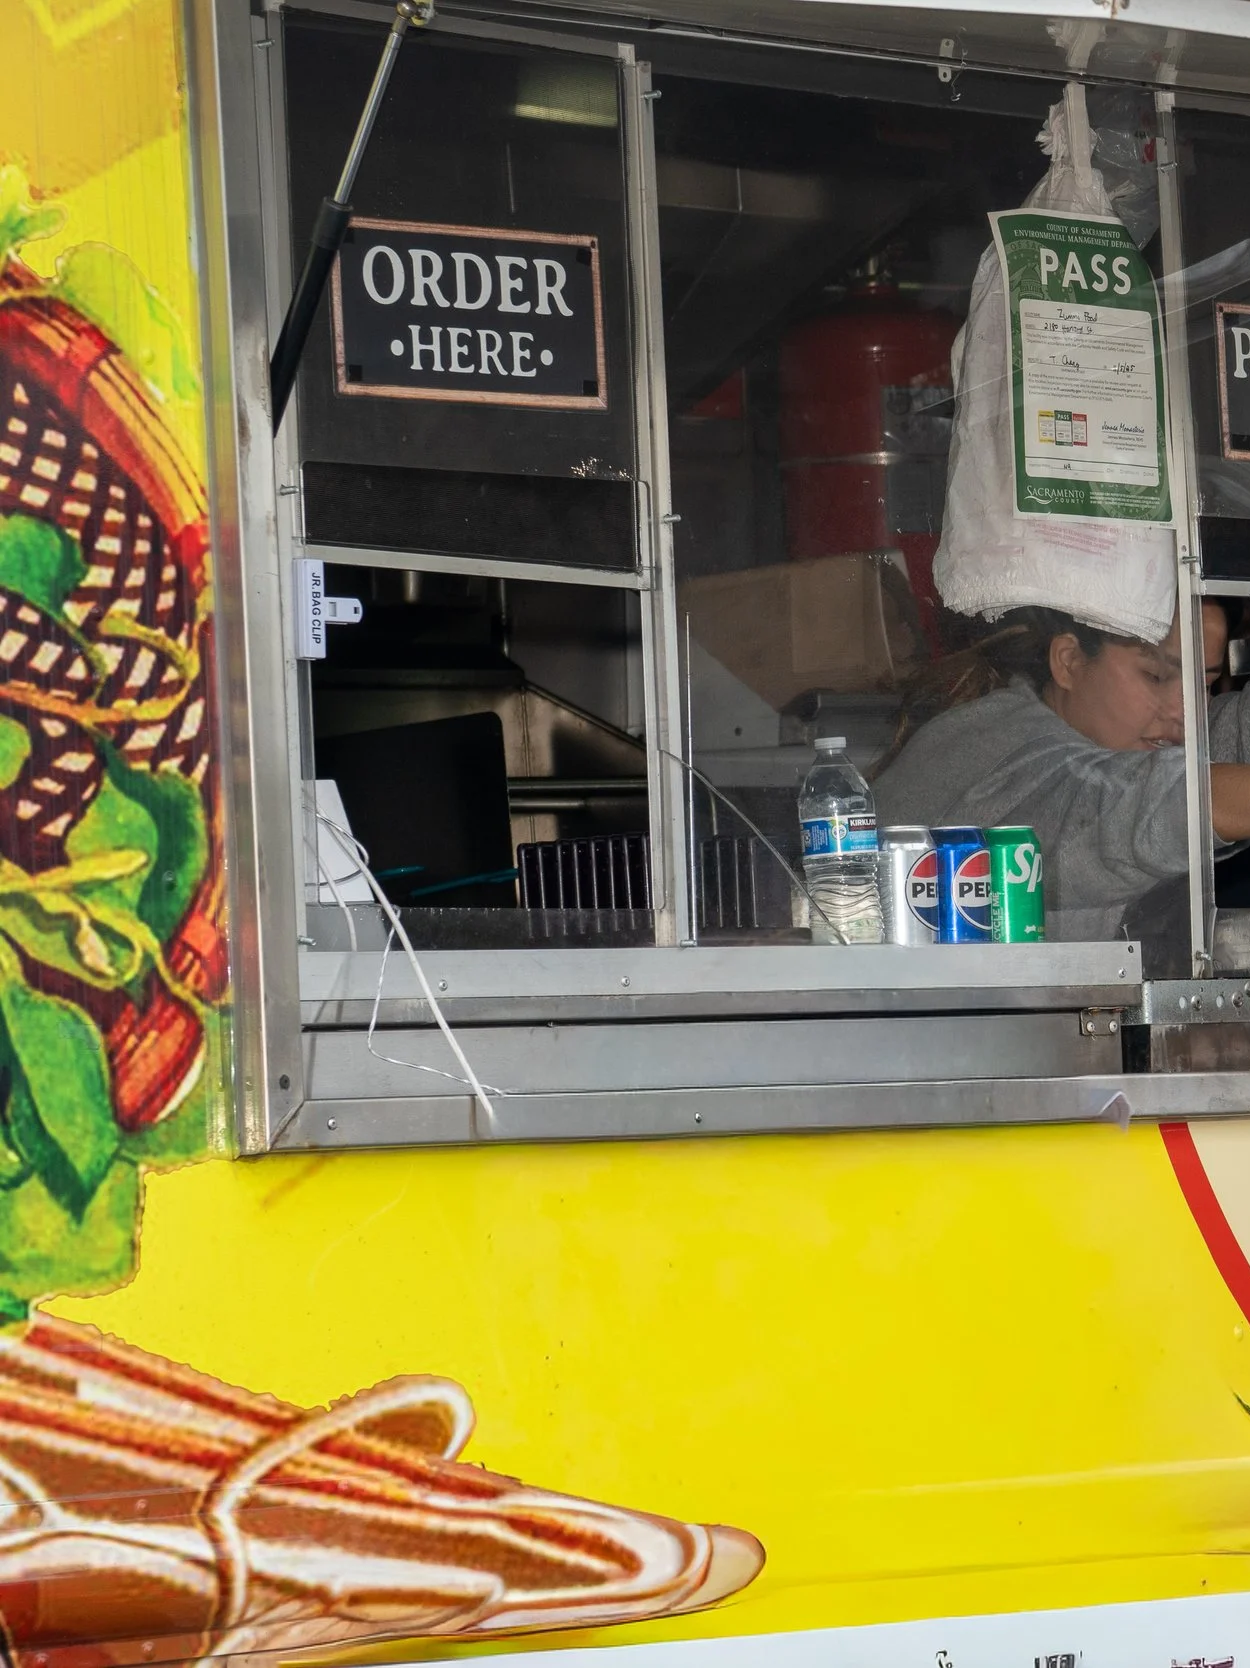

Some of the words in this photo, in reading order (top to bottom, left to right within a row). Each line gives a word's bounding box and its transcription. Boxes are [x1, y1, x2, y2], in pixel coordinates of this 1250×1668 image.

[1014, 230, 1066, 242] ENVIRONMENTAL
[1067, 236, 1109, 248] MANAGEMENT
[1046, 224, 1068, 233] COUNTY
[1070, 226, 1080, 234] OF
[1081, 228, 1121, 239] SACRAMENTO
[1039, 248, 1132, 295] PASS
[363, 245, 574, 317] ORDER
[1057, 413, 1071, 421] PASS
[1027, 485, 1085, 499] SACRAMENTO
[311, 572, 322, 616] JR.BAG
[311, 619, 322, 644] CLIP
[912, 882, 938, 899] PE
